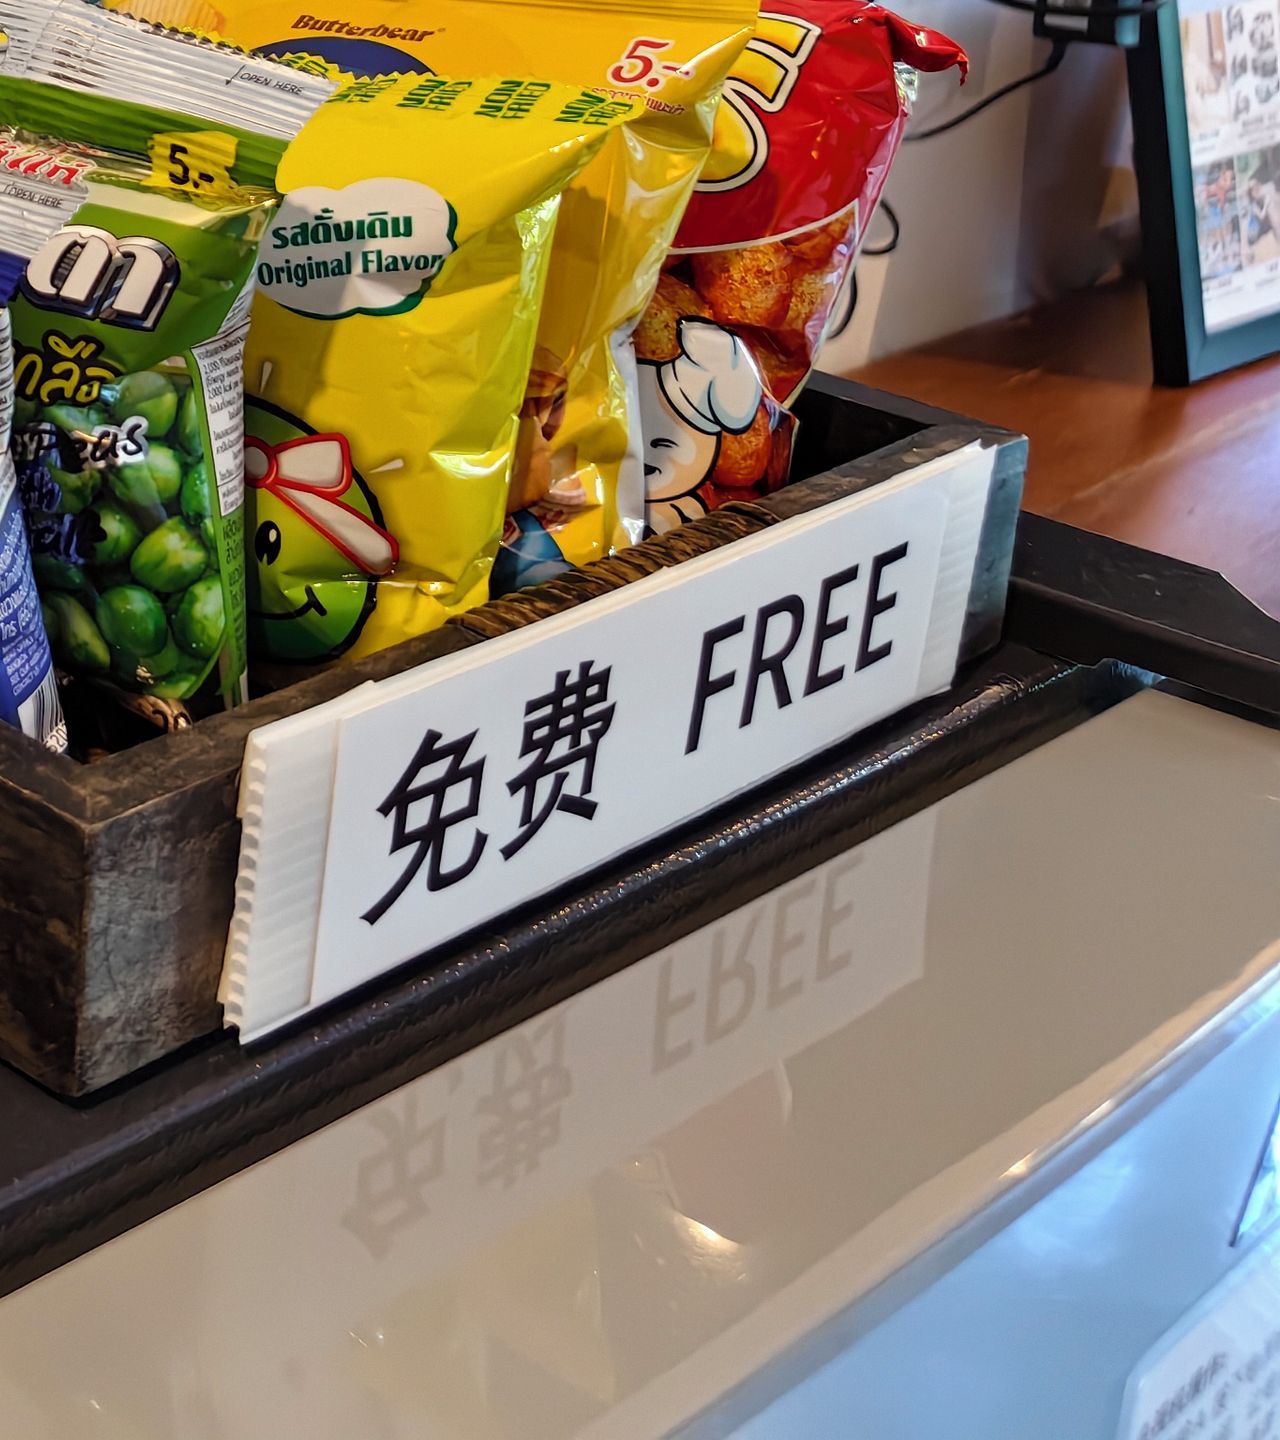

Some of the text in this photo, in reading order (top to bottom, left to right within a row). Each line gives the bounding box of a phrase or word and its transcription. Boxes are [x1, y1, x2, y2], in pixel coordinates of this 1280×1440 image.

[291, 14, 436, 42] Butterbear
[240, 71, 304, 96] OPEN HERE
[396, 79, 449, 109] NON
[474, 79, 525, 118] NON
[500, 82, 551, 120] FRIED
[7, 186, 65, 209] OPEN HERE
[271, 207, 414, 251] รสดั้งเดิม
[257, 248, 446, 289] Original Flavor
[357, 540, 910, 928] 免费 FREE
